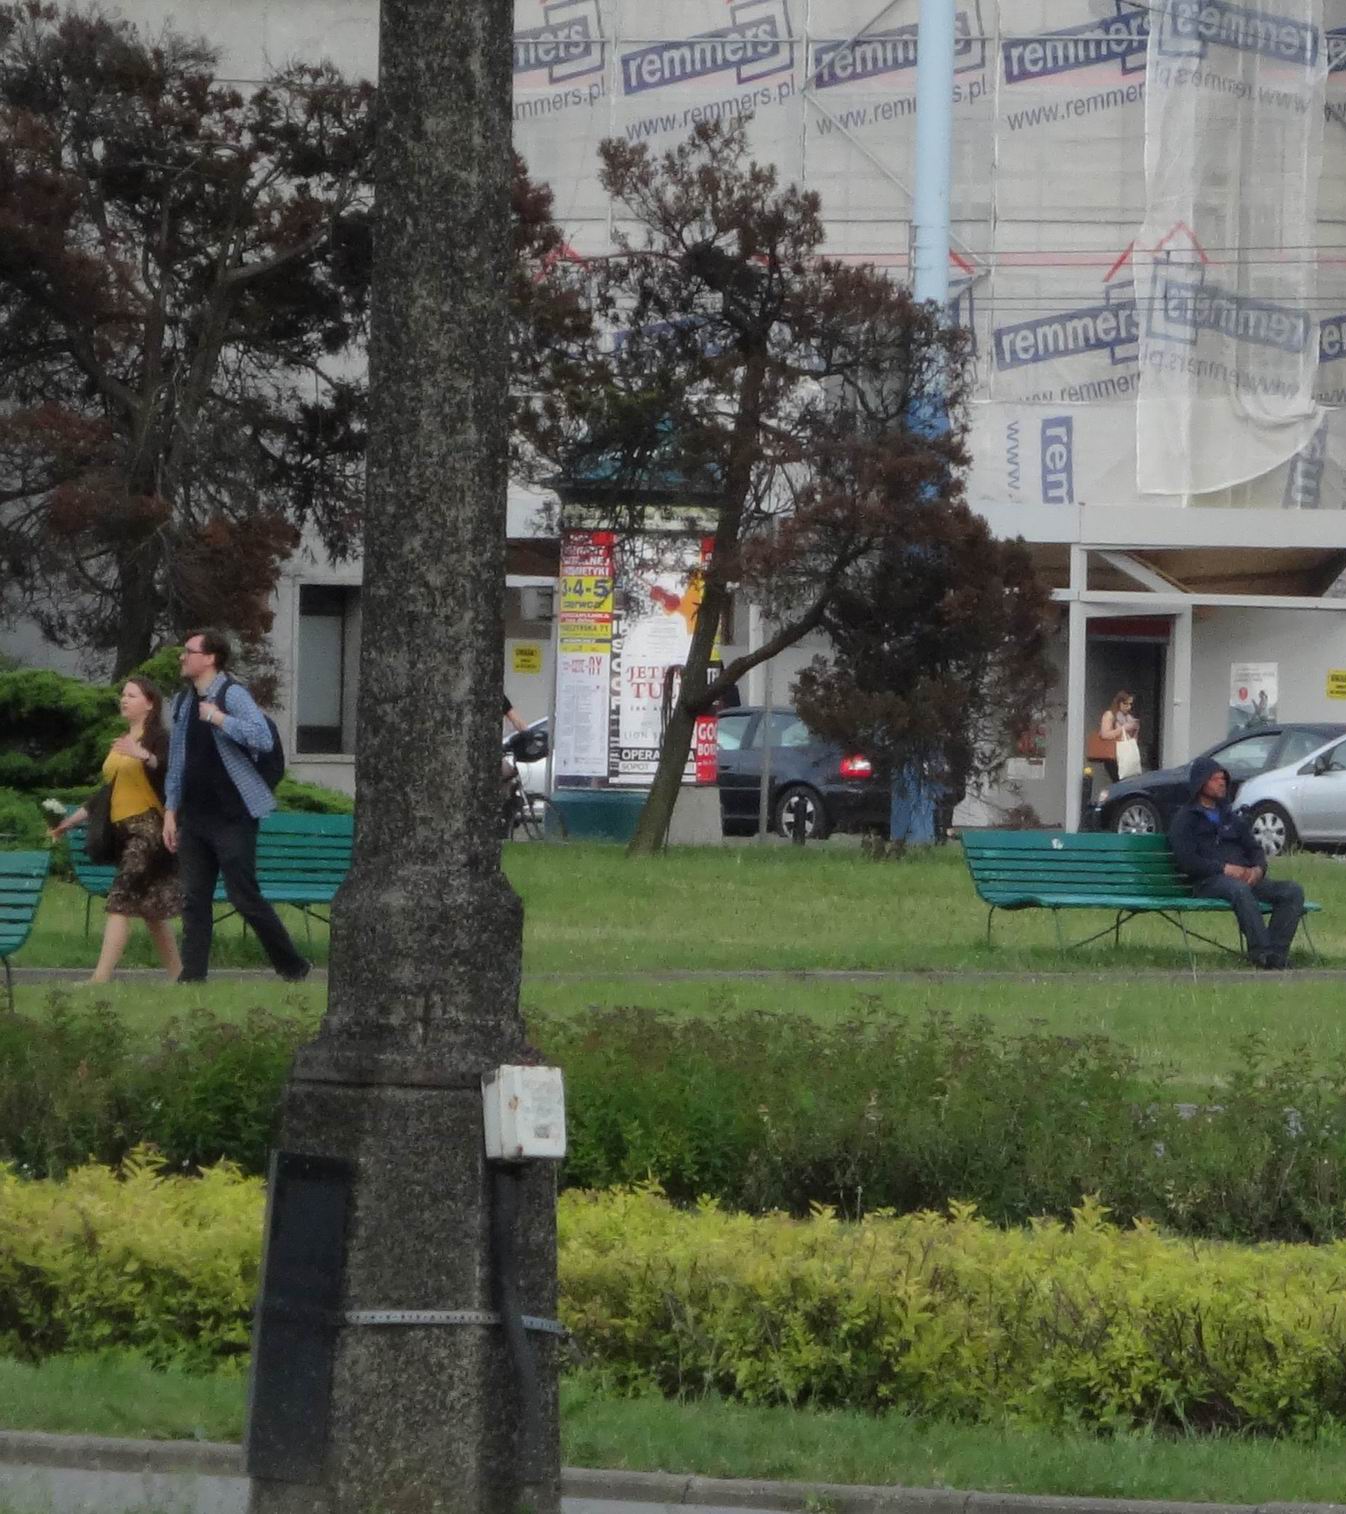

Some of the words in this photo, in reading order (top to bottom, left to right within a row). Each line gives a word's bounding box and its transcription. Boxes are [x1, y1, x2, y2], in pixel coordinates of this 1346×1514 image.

[514, 23, 586, 66] mers
[628, 23, 775, 88] remmers
[820, 25, 970, 82] remms
[514, 78, 606, 121] mmers.pl
[625, 73, 796, 141] www.remmers.pl
[816, 74, 987, 136] www.rems.pl
[1007, 82, 1146, 131] www.remmer
[622, 749, 660, 761] OPERA
